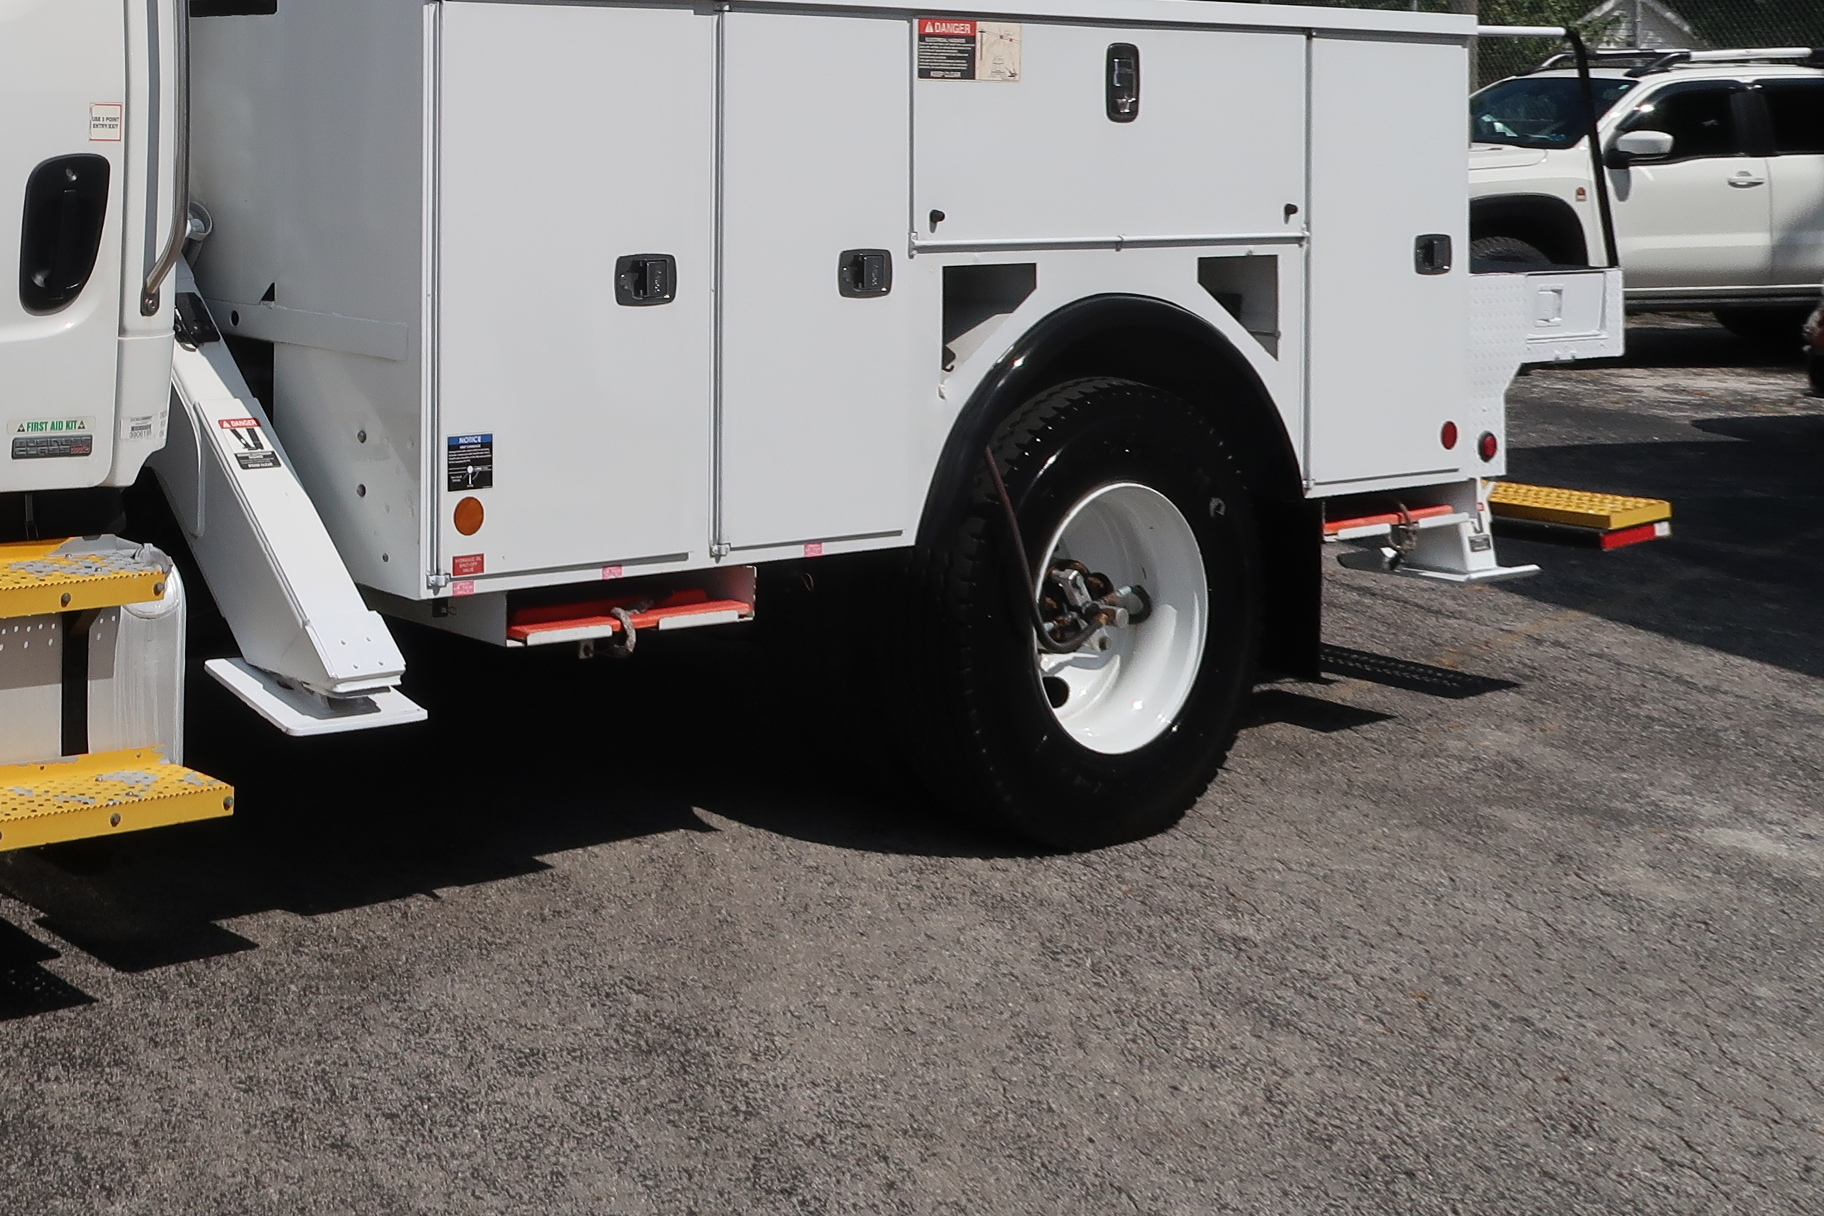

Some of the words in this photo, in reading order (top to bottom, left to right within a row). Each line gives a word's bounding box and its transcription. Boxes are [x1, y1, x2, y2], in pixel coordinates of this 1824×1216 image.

[934, 22, 971, 34] DANGER
[26, 421, 49, 433] FIRST
[50, 420, 64, 431] AID
[65, 419, 78, 430] KIT
[230, 419, 258, 427] DANGER
[458, 435, 482, 444] NOTICE
